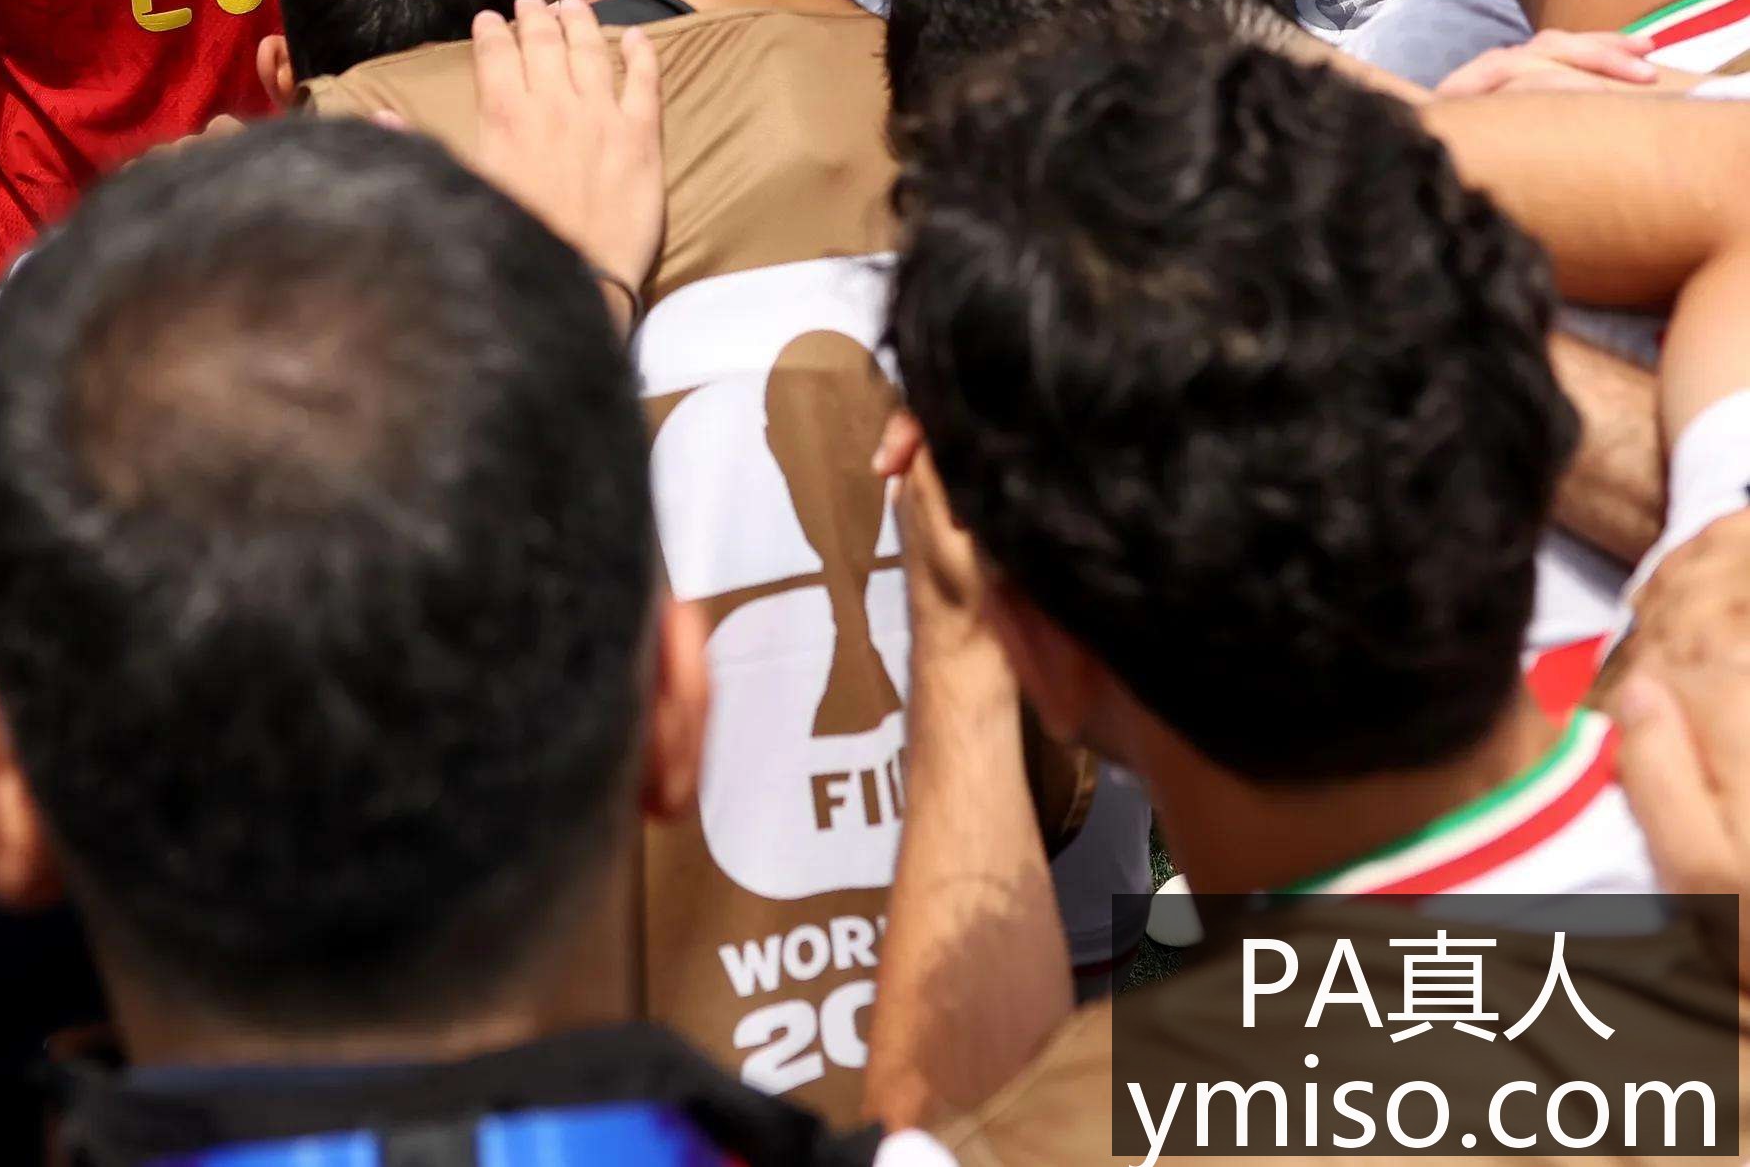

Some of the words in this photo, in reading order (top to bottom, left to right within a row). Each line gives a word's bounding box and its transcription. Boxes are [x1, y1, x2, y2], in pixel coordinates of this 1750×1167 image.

[810, 759, 904, 831] FI
[718, 914, 888, 998] WOR
[733, 980, 877, 1097] 20
